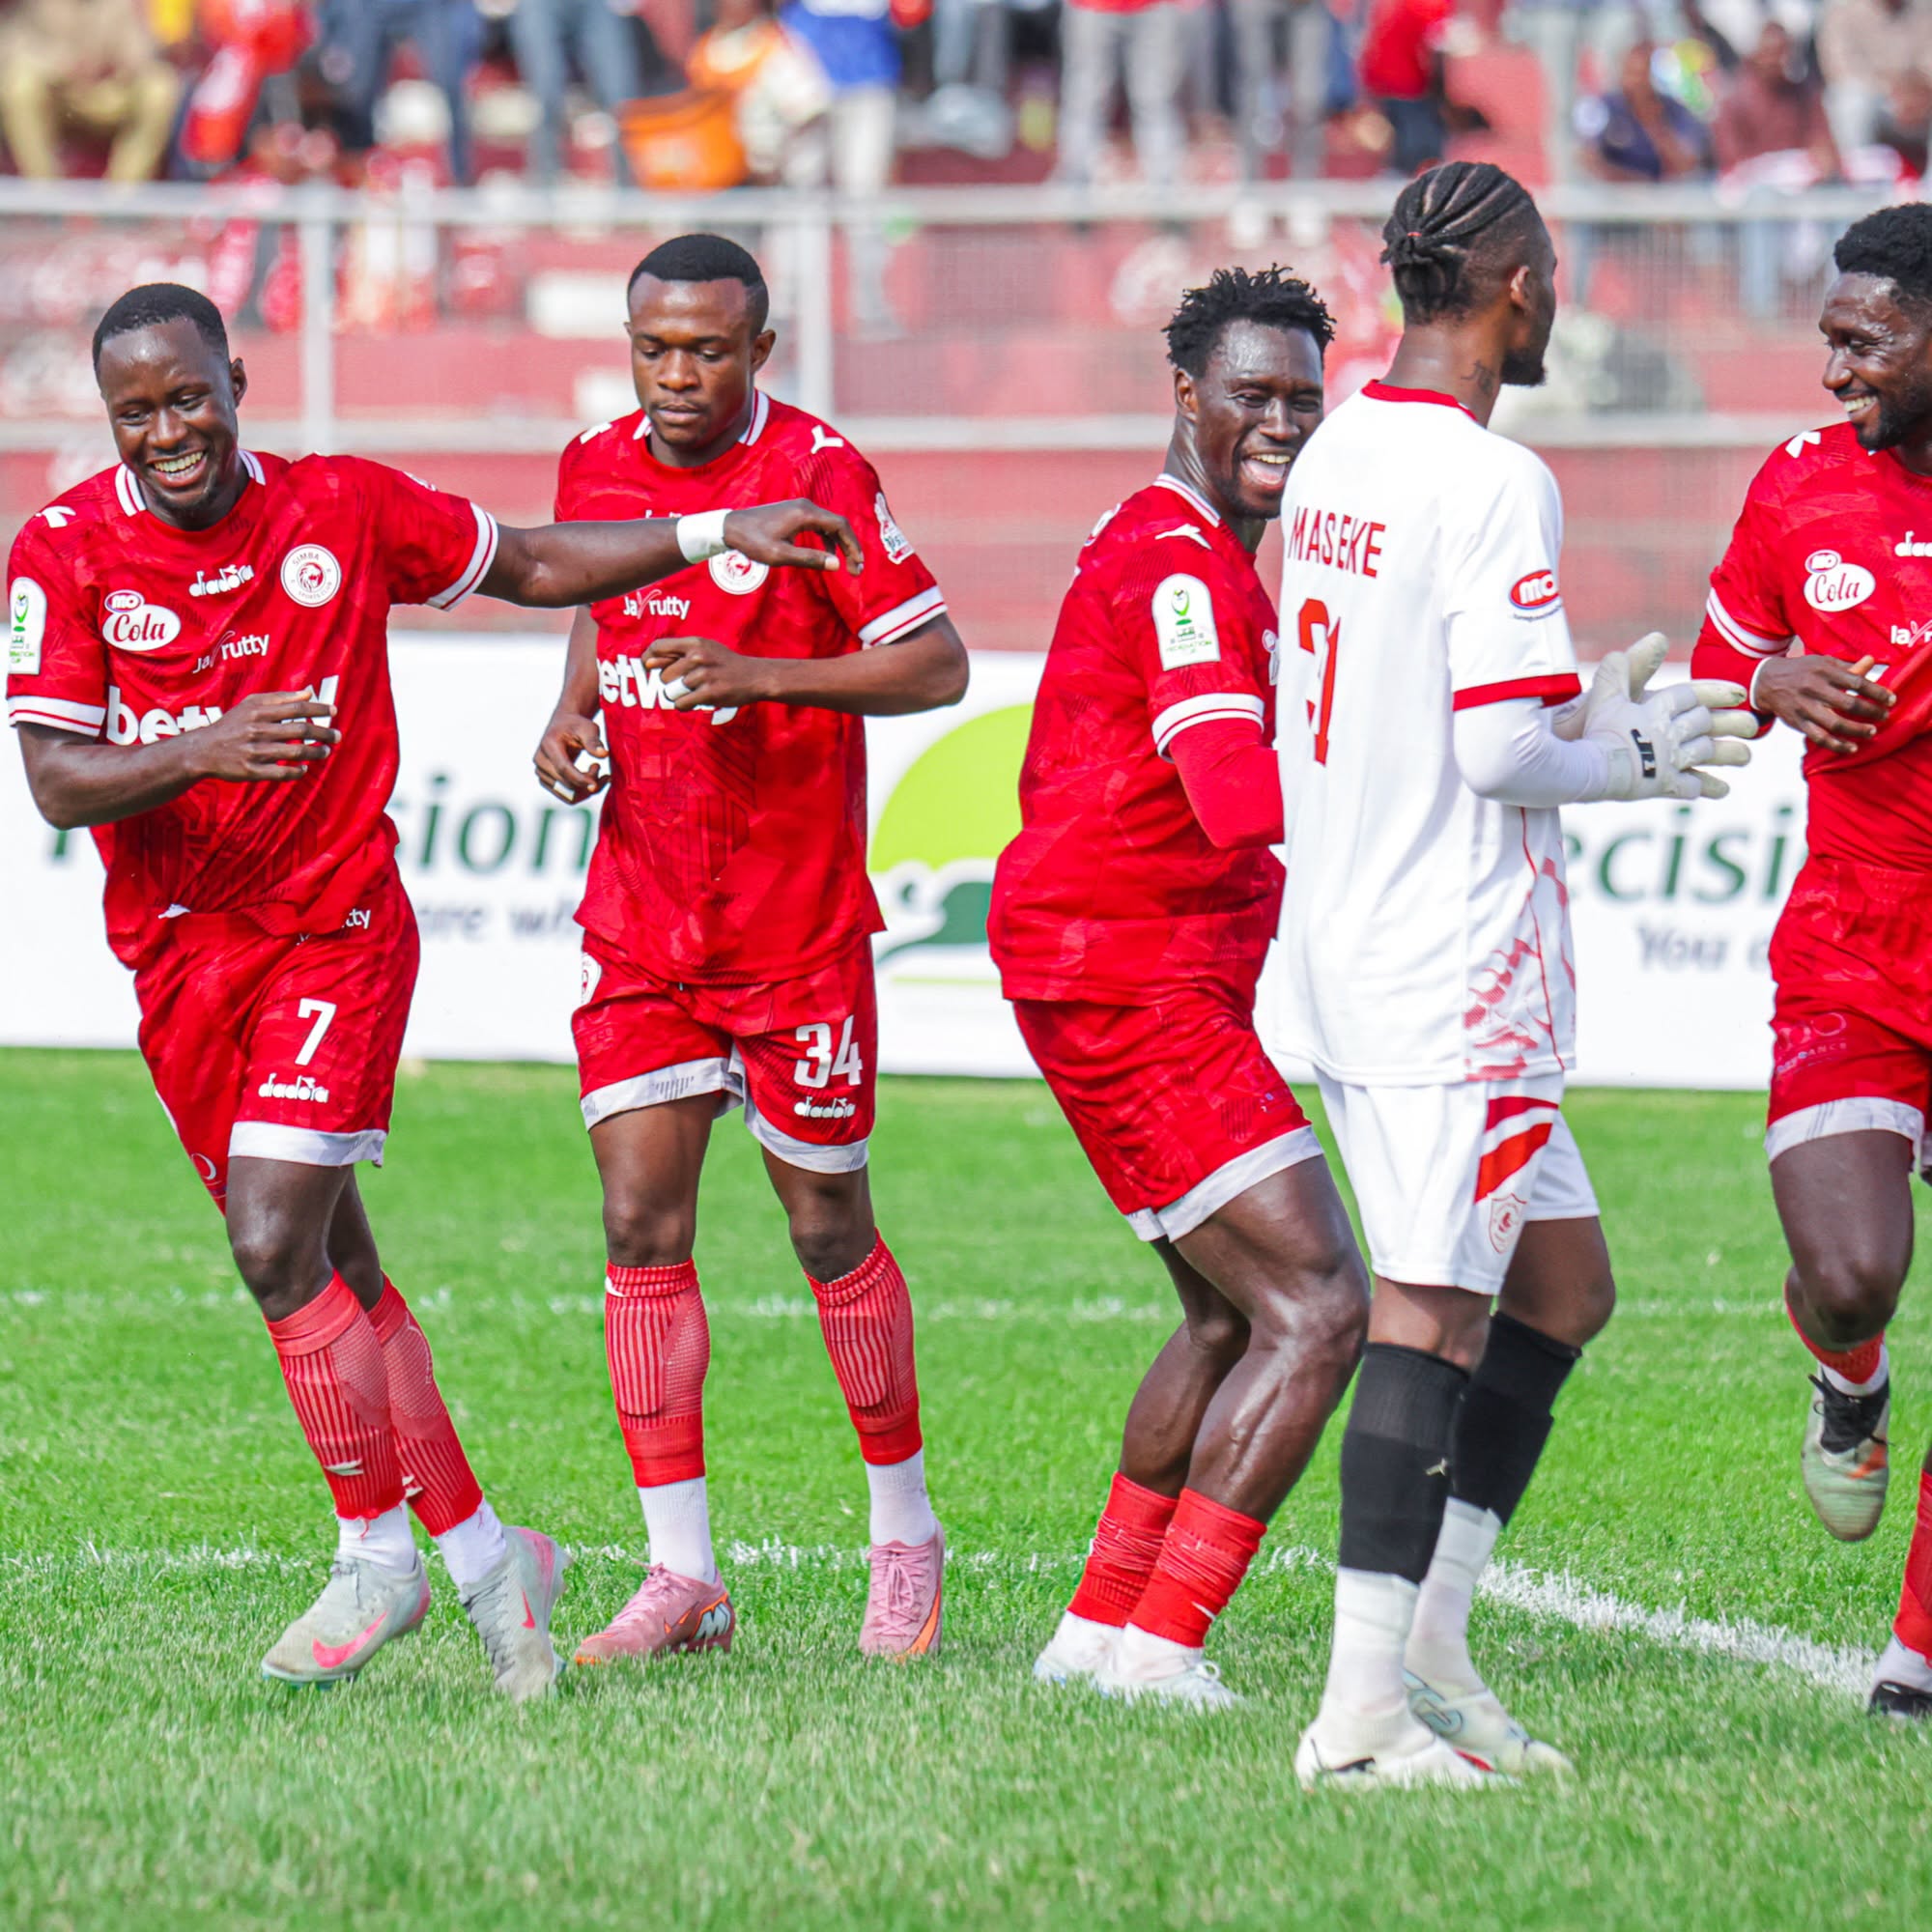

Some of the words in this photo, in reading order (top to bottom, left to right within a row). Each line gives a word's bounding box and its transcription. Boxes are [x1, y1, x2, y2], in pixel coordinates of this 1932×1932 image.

[1288, 505, 1386, 579] MASEKE
[188, 564, 255, 597] diadora
[1814, 573, 1861, 604] Cola
[113, 613, 166, 642] Cola
[295, 997, 337, 1066] 7
[794, 1014, 864, 1089] 34
[258, 1072, 329, 1104] diadora
[794, 1095, 856, 1119] diadora
